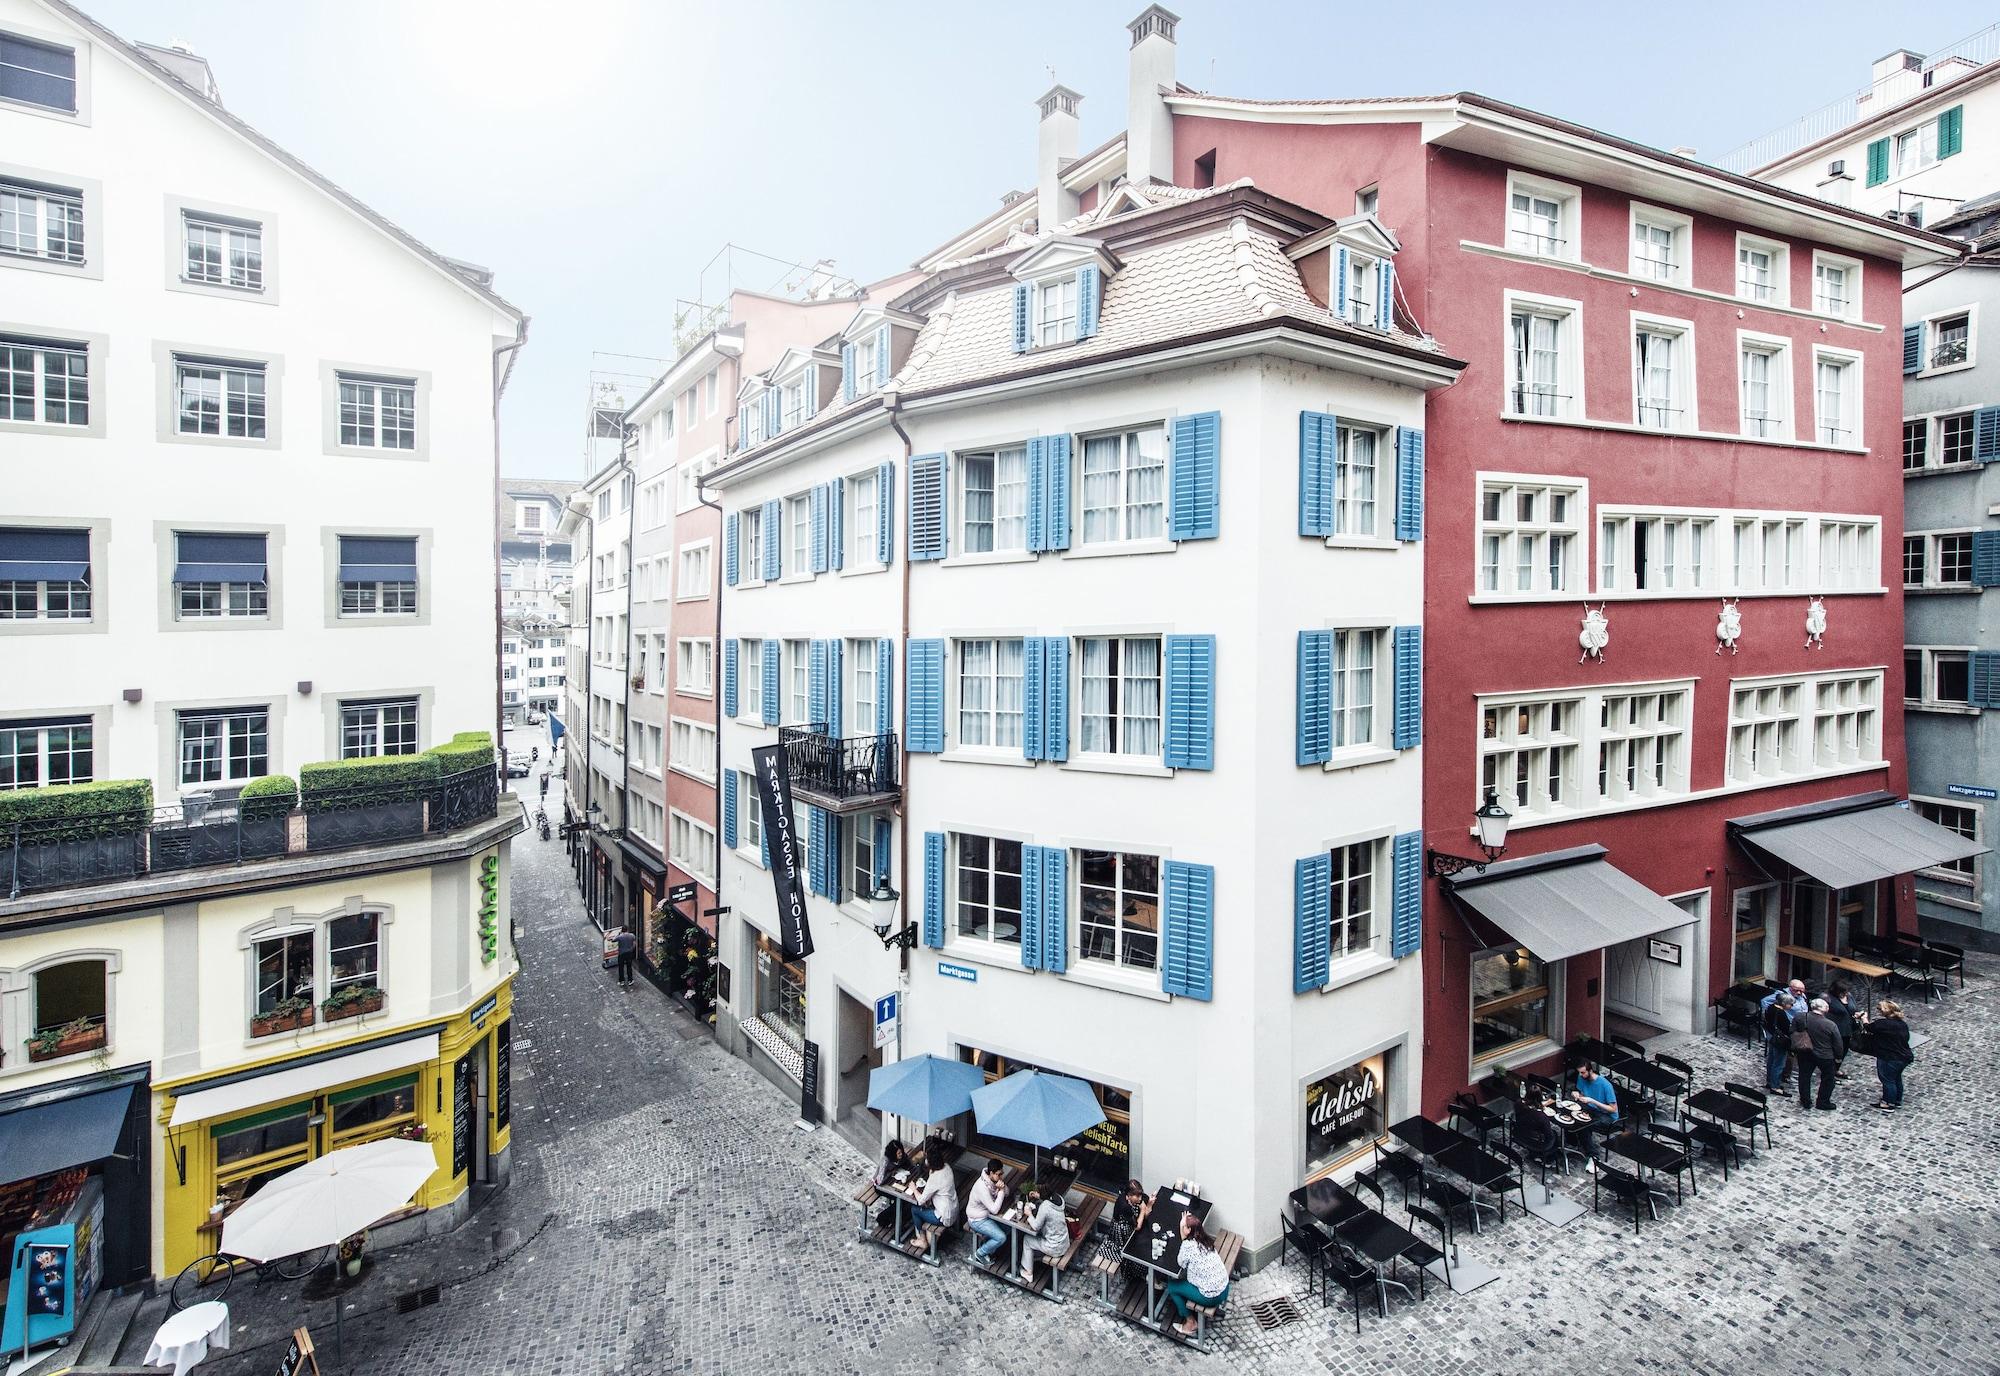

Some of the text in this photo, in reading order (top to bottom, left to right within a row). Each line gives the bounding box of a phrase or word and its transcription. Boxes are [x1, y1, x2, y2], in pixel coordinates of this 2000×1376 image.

[1949, 785, 1995, 797] Metzgergasse
[940, 965, 975, 979] Marktgasse
[1311, 1072, 1374, 1126] delish
[1339, 1106, 1365, 1126] TAKE-OUT
